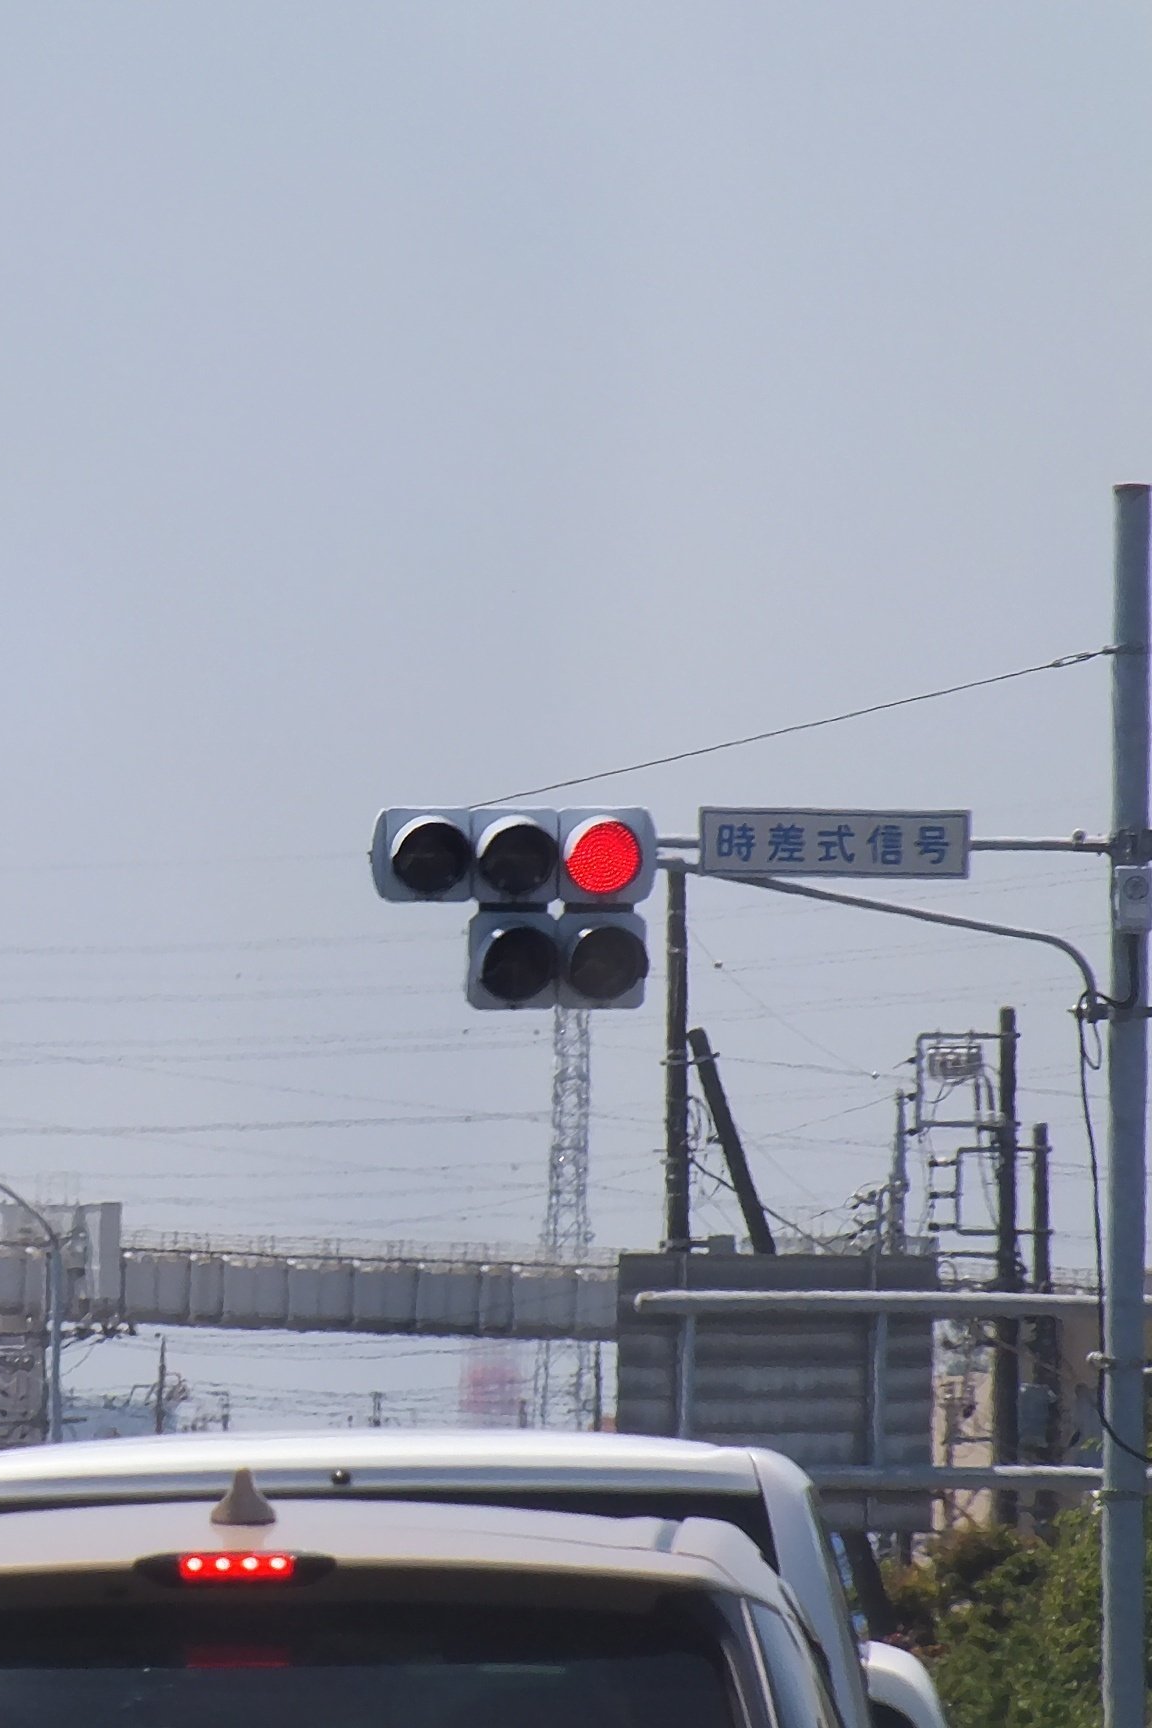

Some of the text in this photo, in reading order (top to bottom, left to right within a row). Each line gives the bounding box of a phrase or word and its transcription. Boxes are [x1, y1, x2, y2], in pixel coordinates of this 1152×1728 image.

[716, 823, 949, 865] 時差式信号
